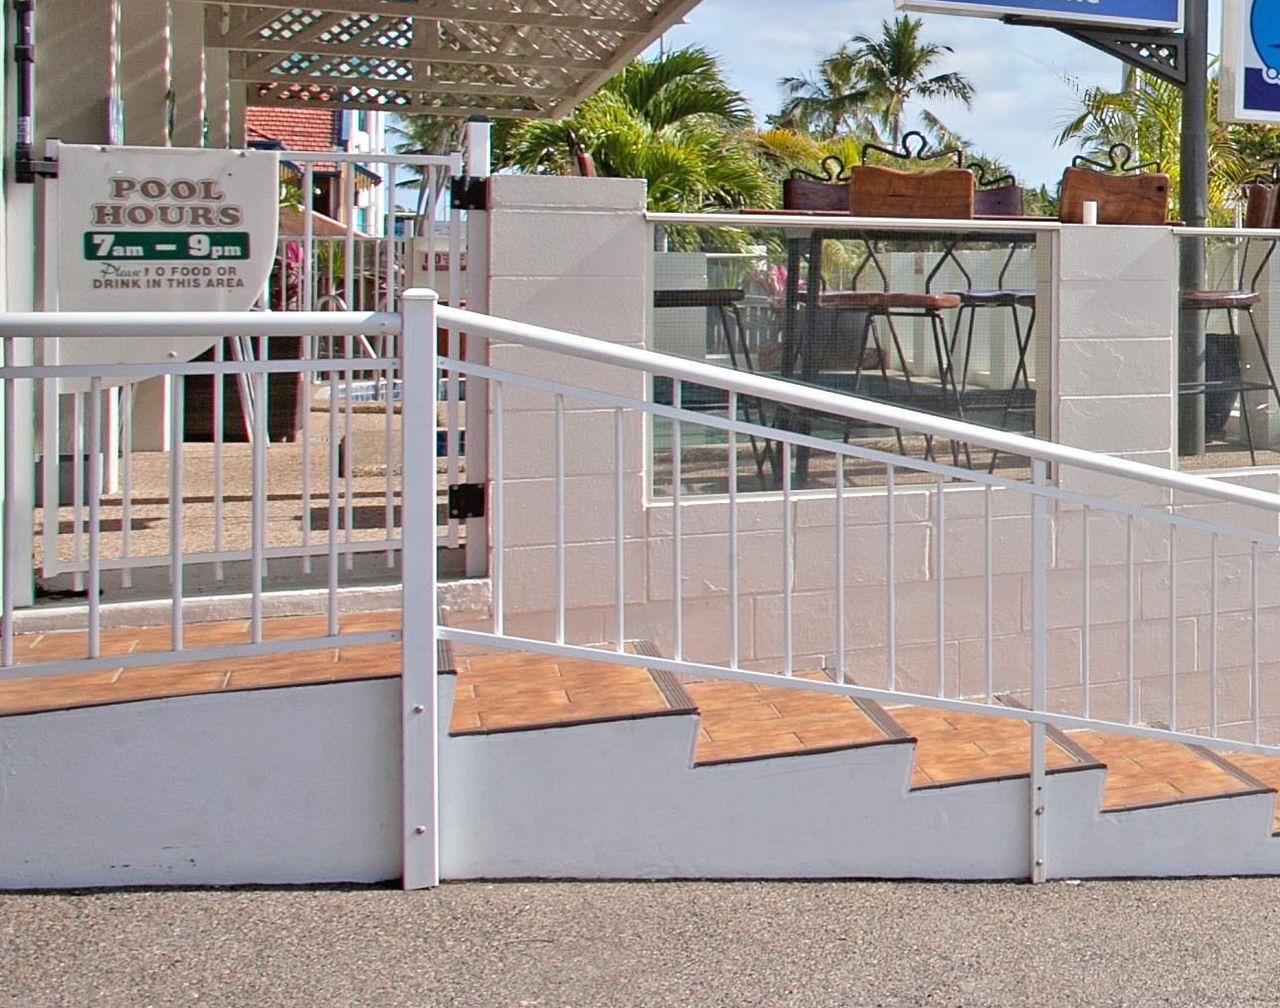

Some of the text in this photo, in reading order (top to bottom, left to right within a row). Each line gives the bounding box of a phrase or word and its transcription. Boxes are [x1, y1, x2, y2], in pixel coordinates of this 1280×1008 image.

[111, 178, 224, 201] POOL
[93, 204, 242, 226] HOURS
[92, 233, 144, 257] 7am
[188, 233, 241, 259] 9pm
[171, 266, 212, 277] FOOD
[217, 266, 237, 277] OR
[93, 278, 244, 289] DRINK IN THIS AREA
